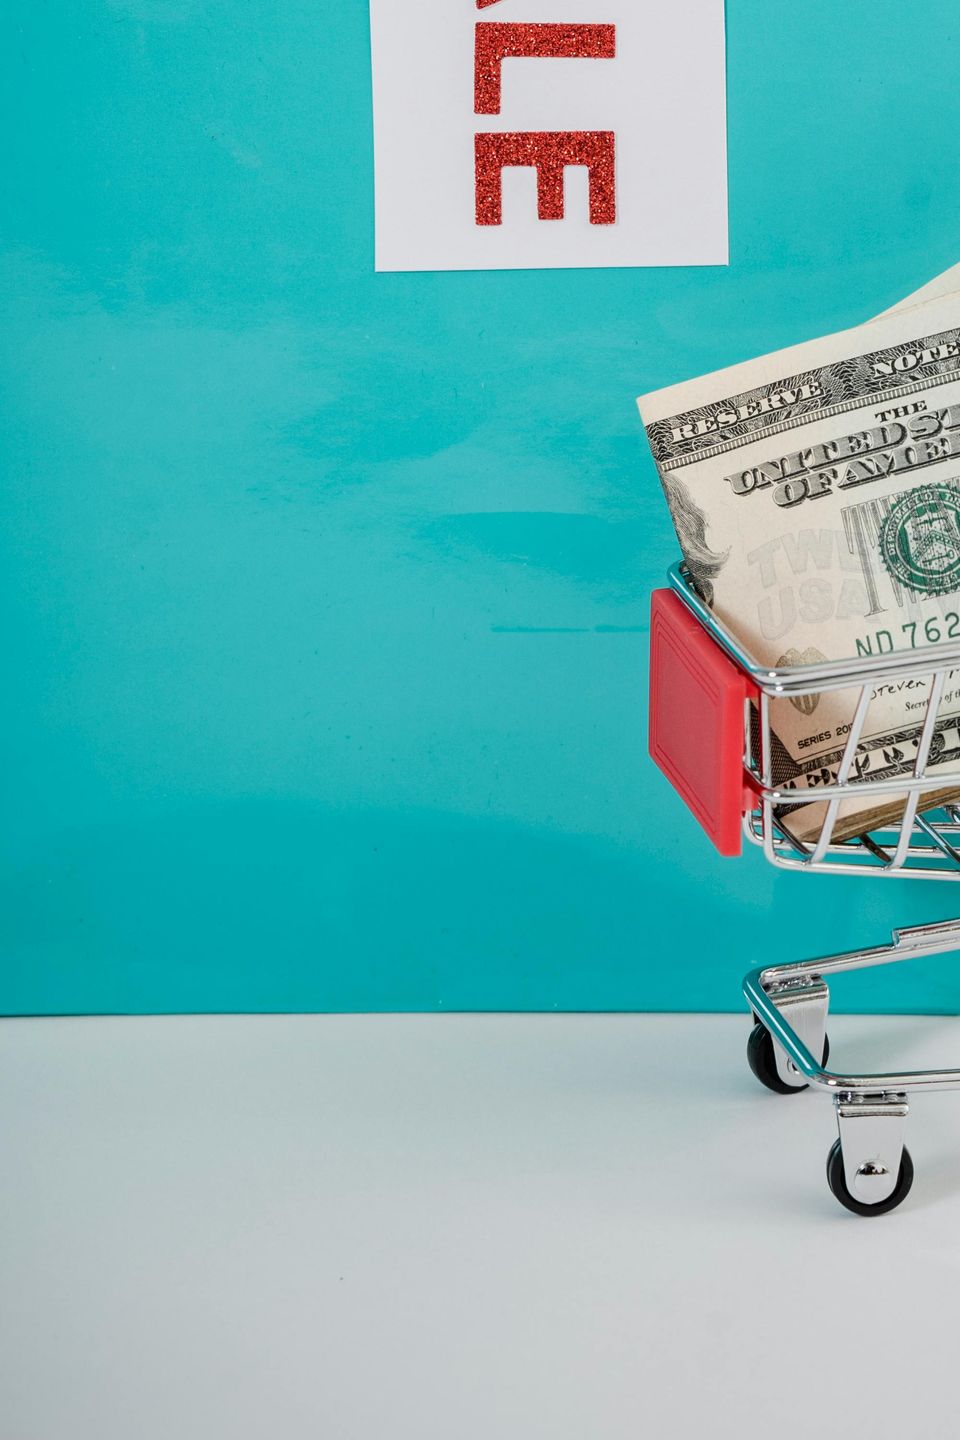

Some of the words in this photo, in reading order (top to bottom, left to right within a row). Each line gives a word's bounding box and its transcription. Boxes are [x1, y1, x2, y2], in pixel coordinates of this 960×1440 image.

[670, 380, 826, 446] RESERVE
[874, 399, 929, 424] THE
[723, 421, 909, 497] UNITED
[771, 468, 840, 509] OF
[756, 576, 871, 642] USA
[854, 629, 895, 658] ND
[944, 691, 955, 704] of
[797, 730, 832, 750] SERIES
